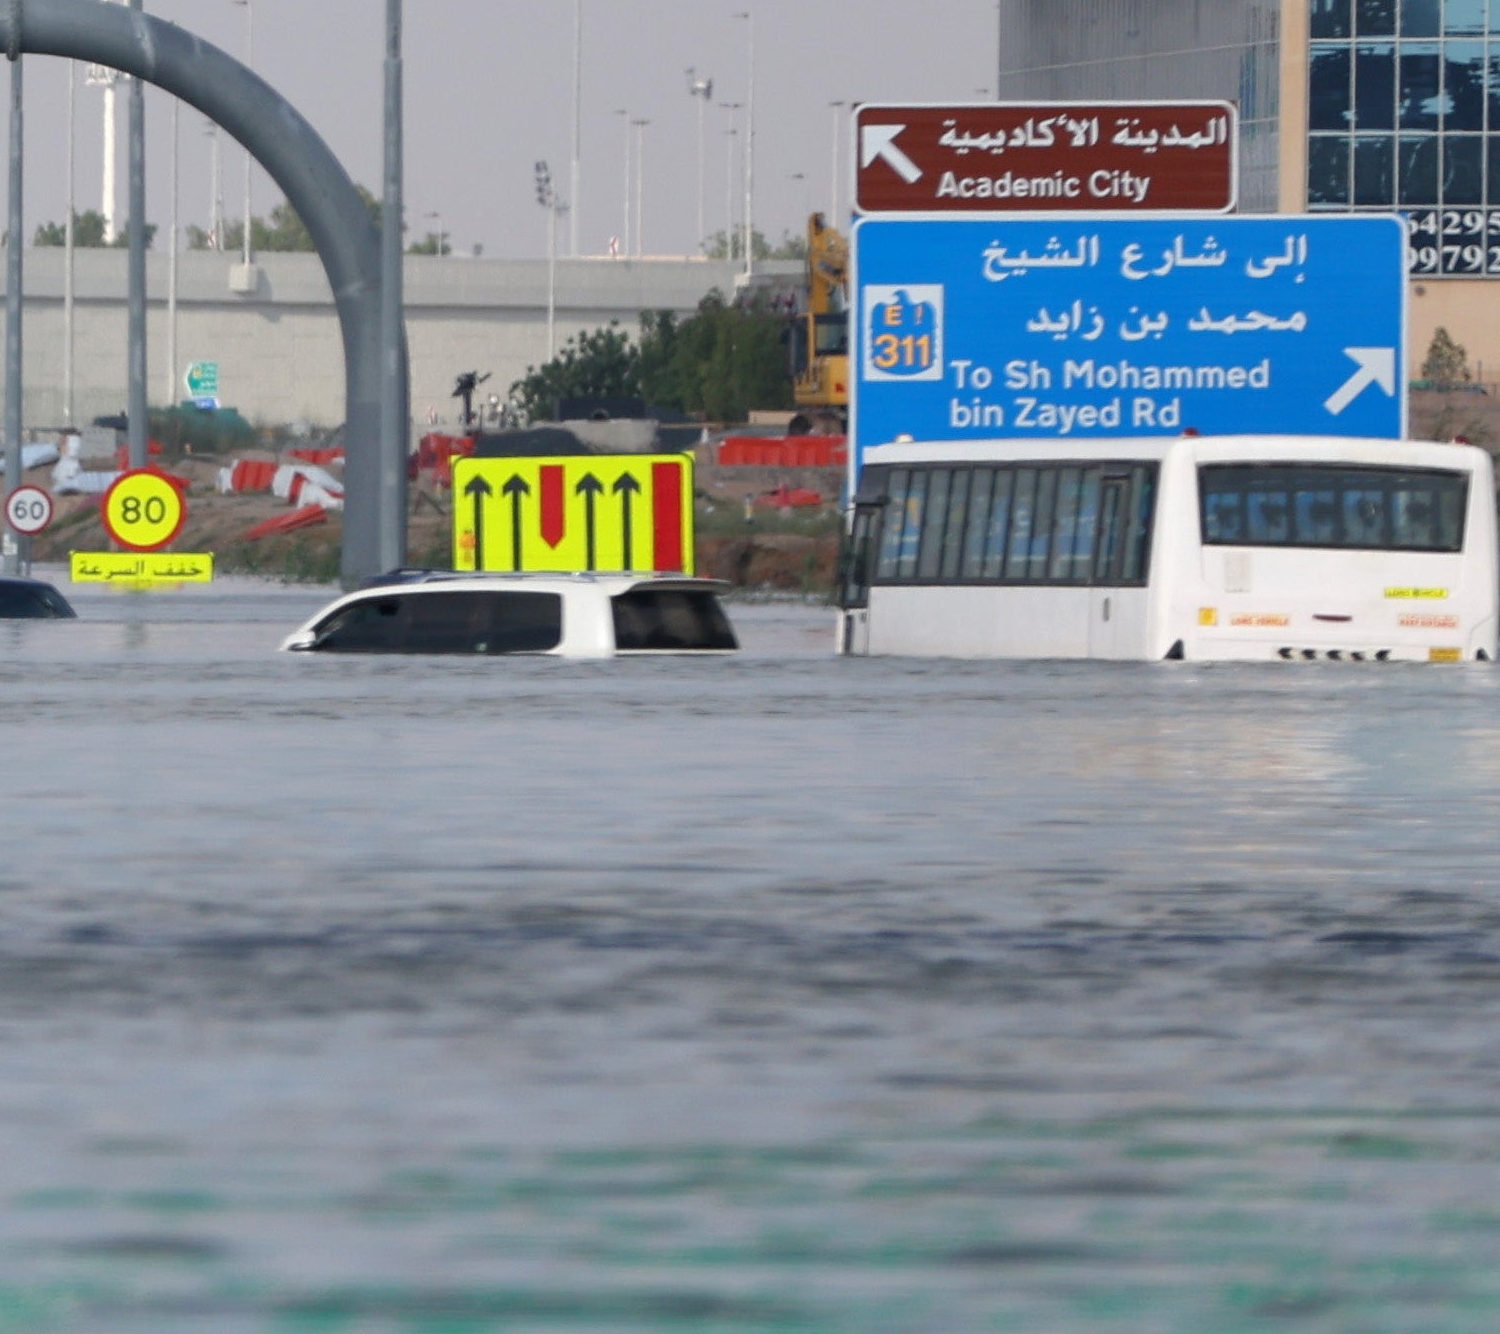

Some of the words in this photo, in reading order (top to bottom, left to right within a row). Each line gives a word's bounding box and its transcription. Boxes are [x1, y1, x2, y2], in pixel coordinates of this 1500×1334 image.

[938, 113, 1099, 155] الأكاديمية
[1111, 116, 1228, 153] المدينة
[935, 170, 1080, 199] Academic
[1089, 169, 1151, 203] City
[981, 235, 1099, 281] الشيخ
[1121, 234, 1228, 280] شارع
[1247, 234, 1308, 284] إلى
[884, 305, 902, 326] E
[1026, 301, 1103, 340] زايد
[1119, 310, 1168, 340] بن
[1188, 308, 1308, 334] محمد
[874, 333, 930, 370] 311
[951, 359, 992, 389] To
[1005, 359, 1051, 389] Sh
[1064, 359, 1270, 389] Mohammed
[950, 398, 1003, 427] bin
[1013, 398, 1121, 434] Zayed
[1133, 398, 1181, 428] Rd
[14, 501, 45, 519] 60
[121, 496, 166, 524] 80
[78, 560, 145, 579] السرعة
[153, 561, 203, 578] خفف
